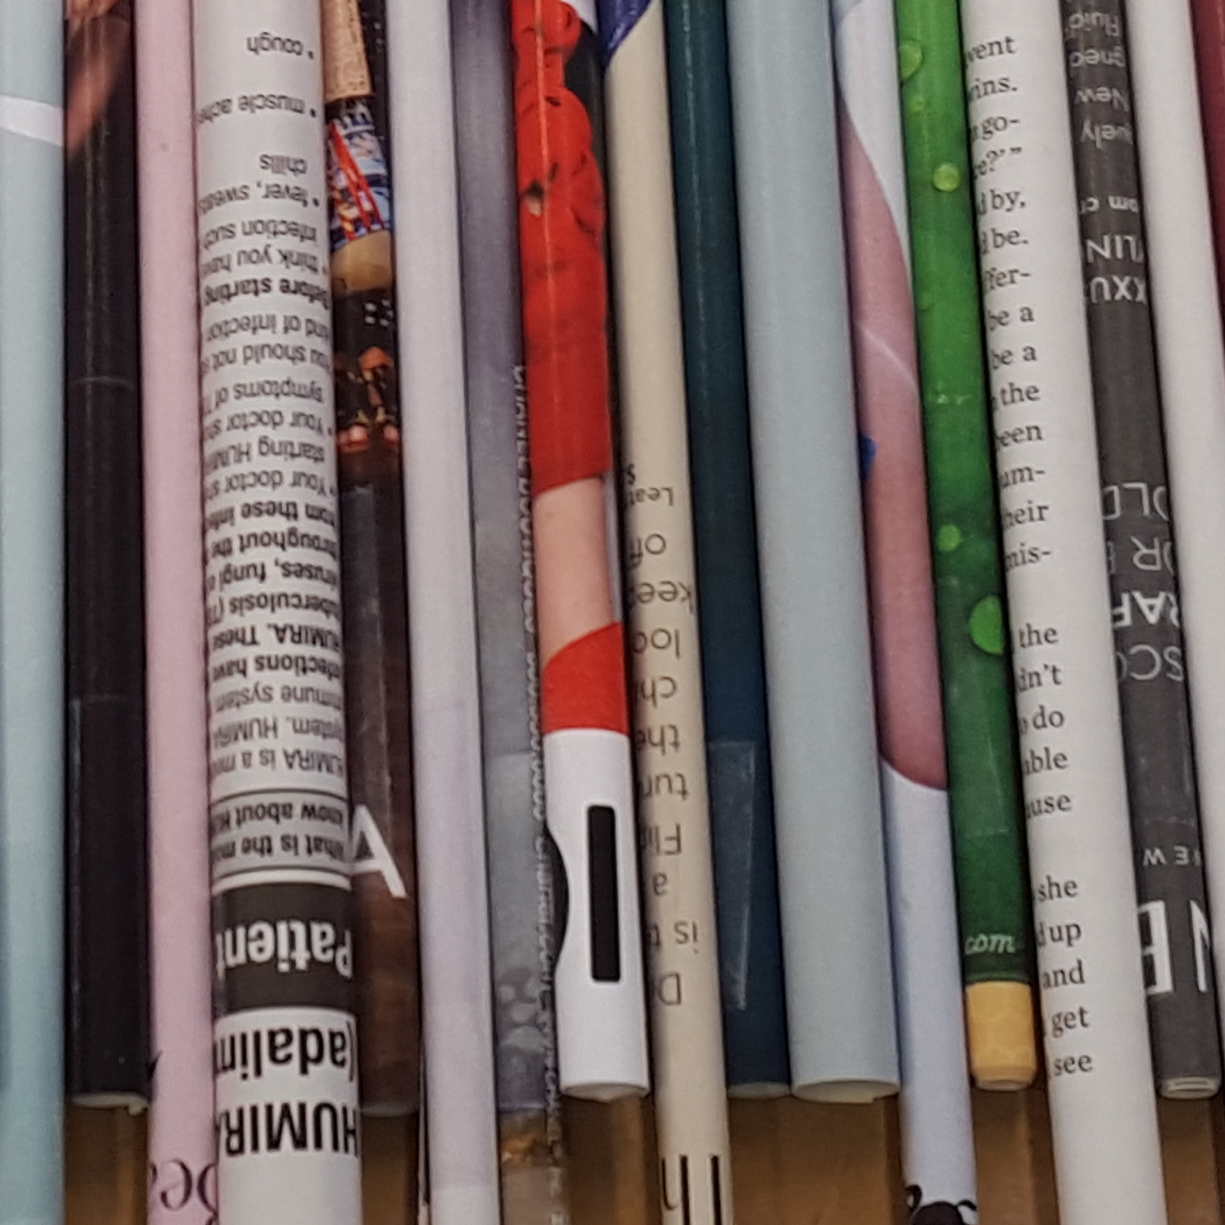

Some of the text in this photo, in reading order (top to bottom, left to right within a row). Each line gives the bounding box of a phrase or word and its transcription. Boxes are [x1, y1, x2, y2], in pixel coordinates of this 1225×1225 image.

[247, 32, 303, 56] cough
[239, 94, 305, 115] muscle
[981, 116, 1020, 141] go-
[259, 155, 307, 175] chills
[256, 181, 308, 208] fever,
[990, 189, 1026, 212] by,
[242, 220, 317, 245] infection
[992, 228, 1029, 249] be.
[237, 244, 272, 267] you
[1019, 307, 1034, 323] a
[243, 344, 305, 365] should
[1023, 345, 1037, 362] a
[233, 378, 322, 402] symptoms
[999, 381, 1040, 407] the
[259, 438, 324, 463] starting
[225, 472, 325, 499] Your doctor
[241, 502, 298, 525] these
[1018, 622, 1059, 648] the
[1032, 706, 1065, 731] do
[242, 750, 276, 771] is a
[236, 804, 293, 827] about
[241, 836, 272, 858] the
[281, 835, 298, 856] is
[651, 873, 669, 898] a
[1038, 876, 1078, 903] she
[672, 921, 699, 954] is
[1049, 923, 1082, 948] up
[1052, 1006, 1088, 1038] get
[1053, 1054, 1093, 1075] see
[218, 1102, 359, 1158] HUMIR
